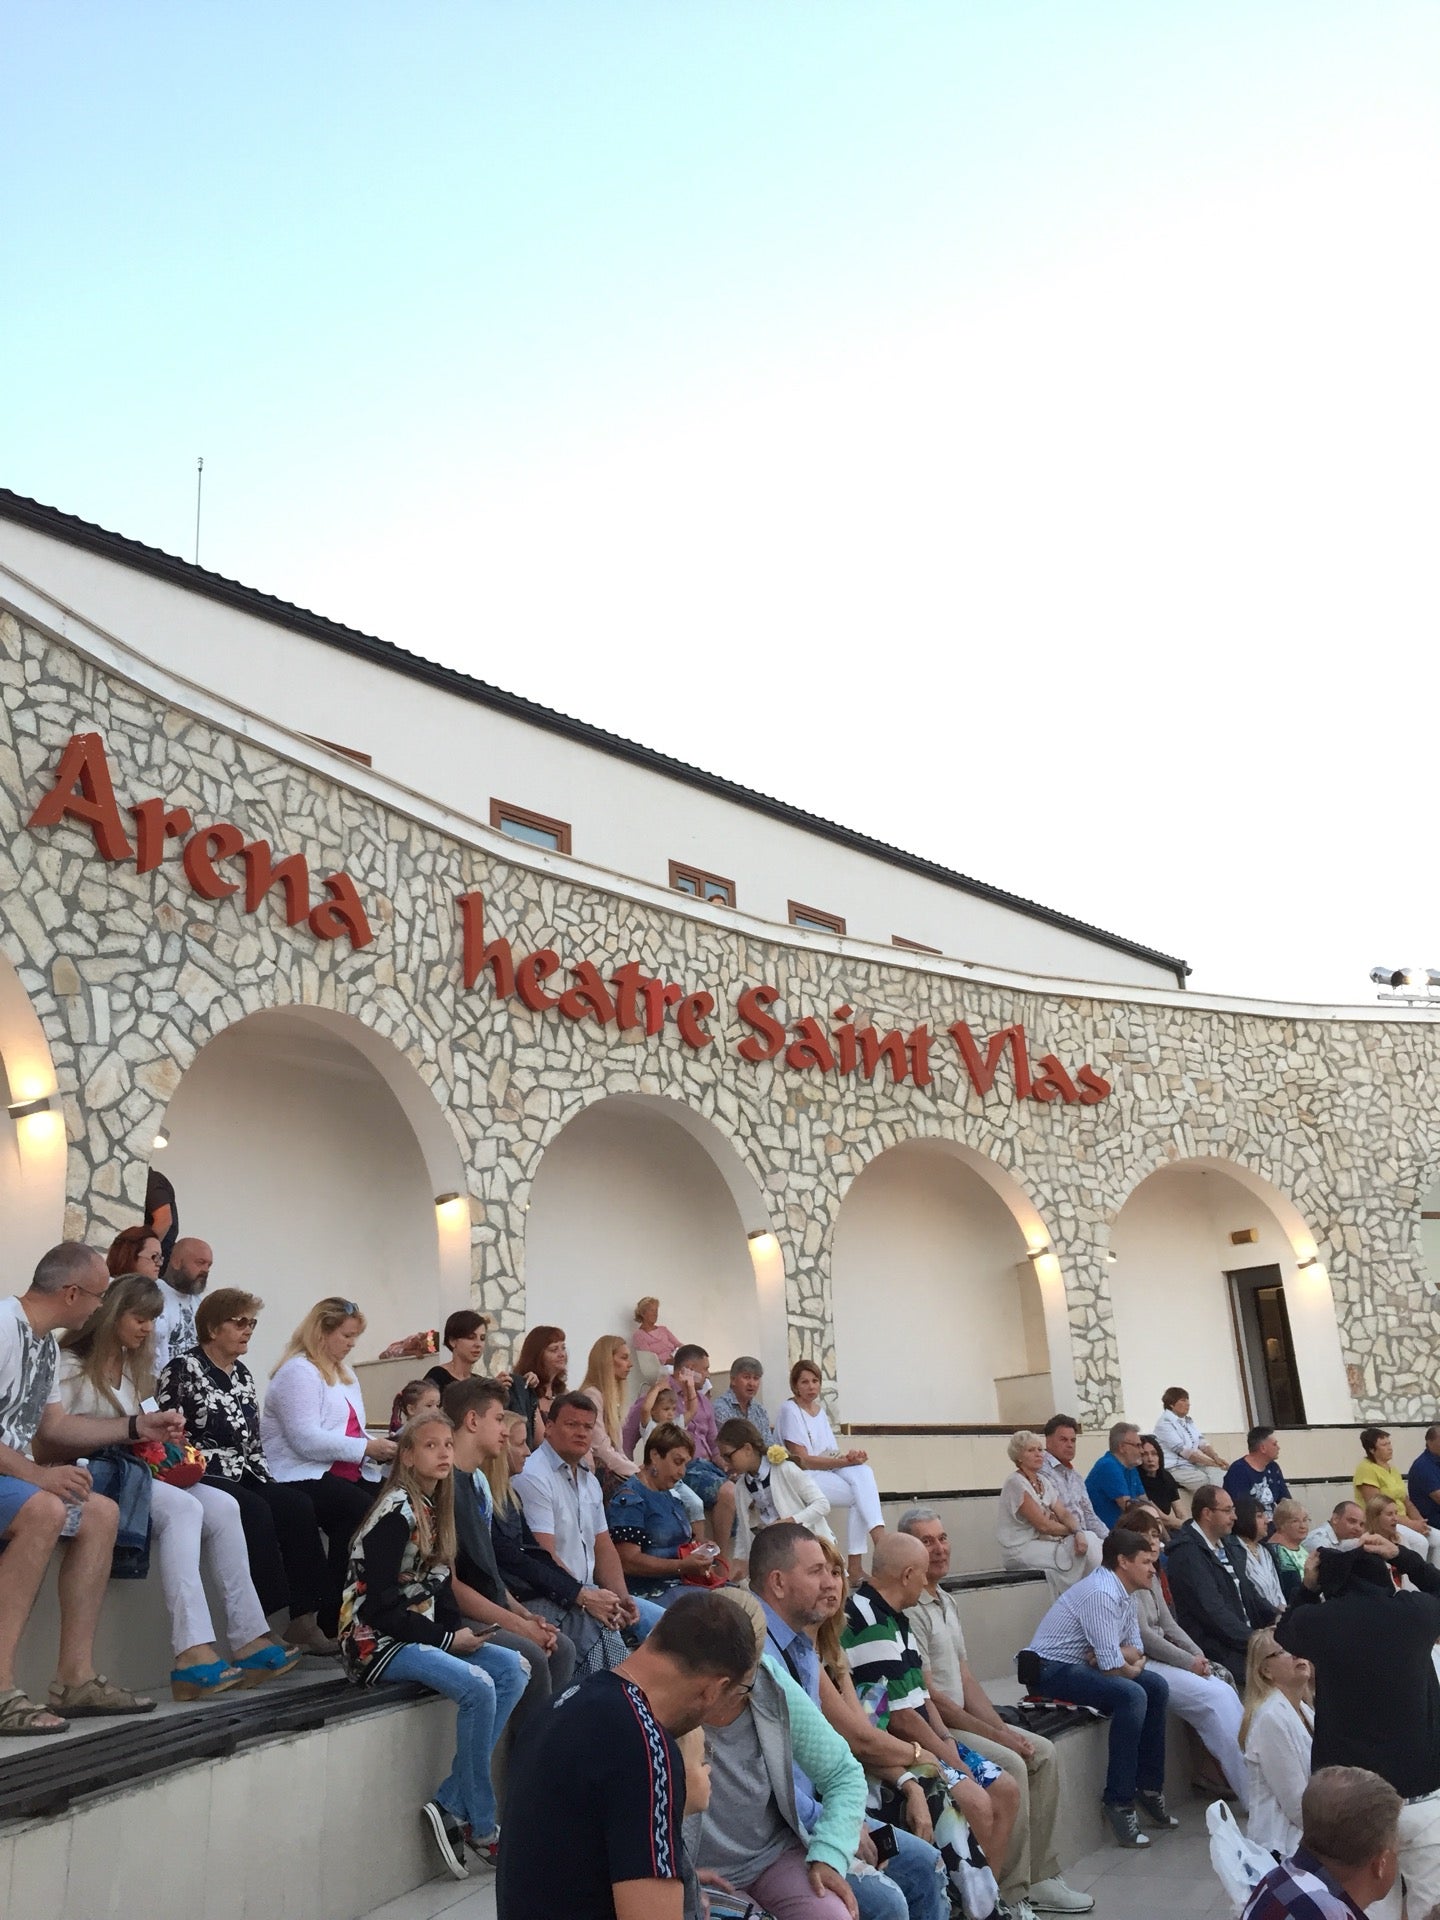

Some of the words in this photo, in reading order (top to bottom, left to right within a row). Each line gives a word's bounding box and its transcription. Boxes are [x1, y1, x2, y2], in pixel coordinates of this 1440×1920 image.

[27, 732, 374, 950] Arena
[738, 985, 936, 1087] Saint
[947, 1020, 1112, 1106] Vlas
